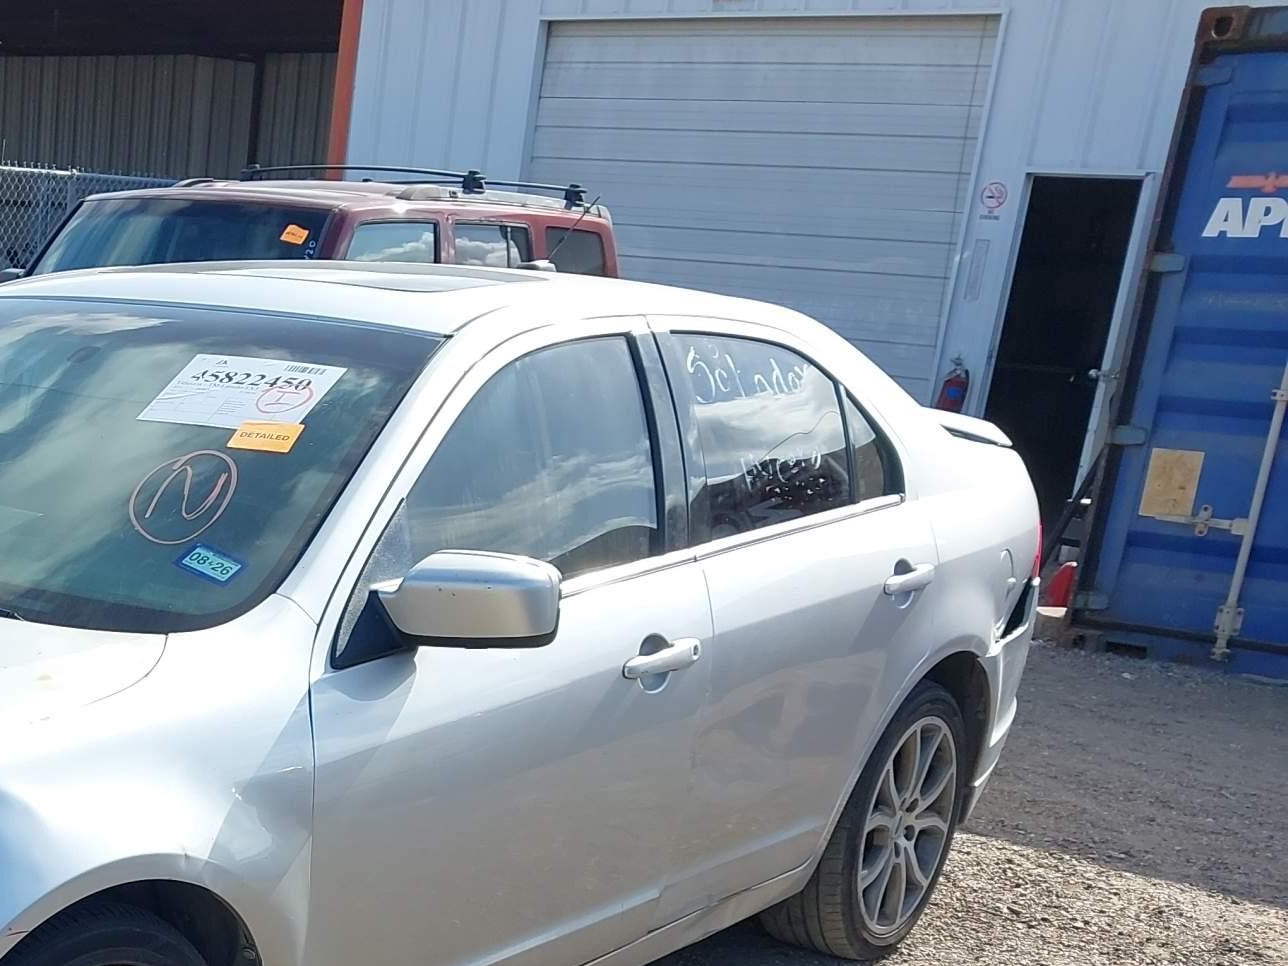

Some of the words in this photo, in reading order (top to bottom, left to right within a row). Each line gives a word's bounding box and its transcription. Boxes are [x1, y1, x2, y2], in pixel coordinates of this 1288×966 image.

[1201, 197, 1288, 238] AP
[191, 369, 312, 391] 45822450
[240, 431, 290, 441] DETAILED
[144, 465, 229, 521] N
